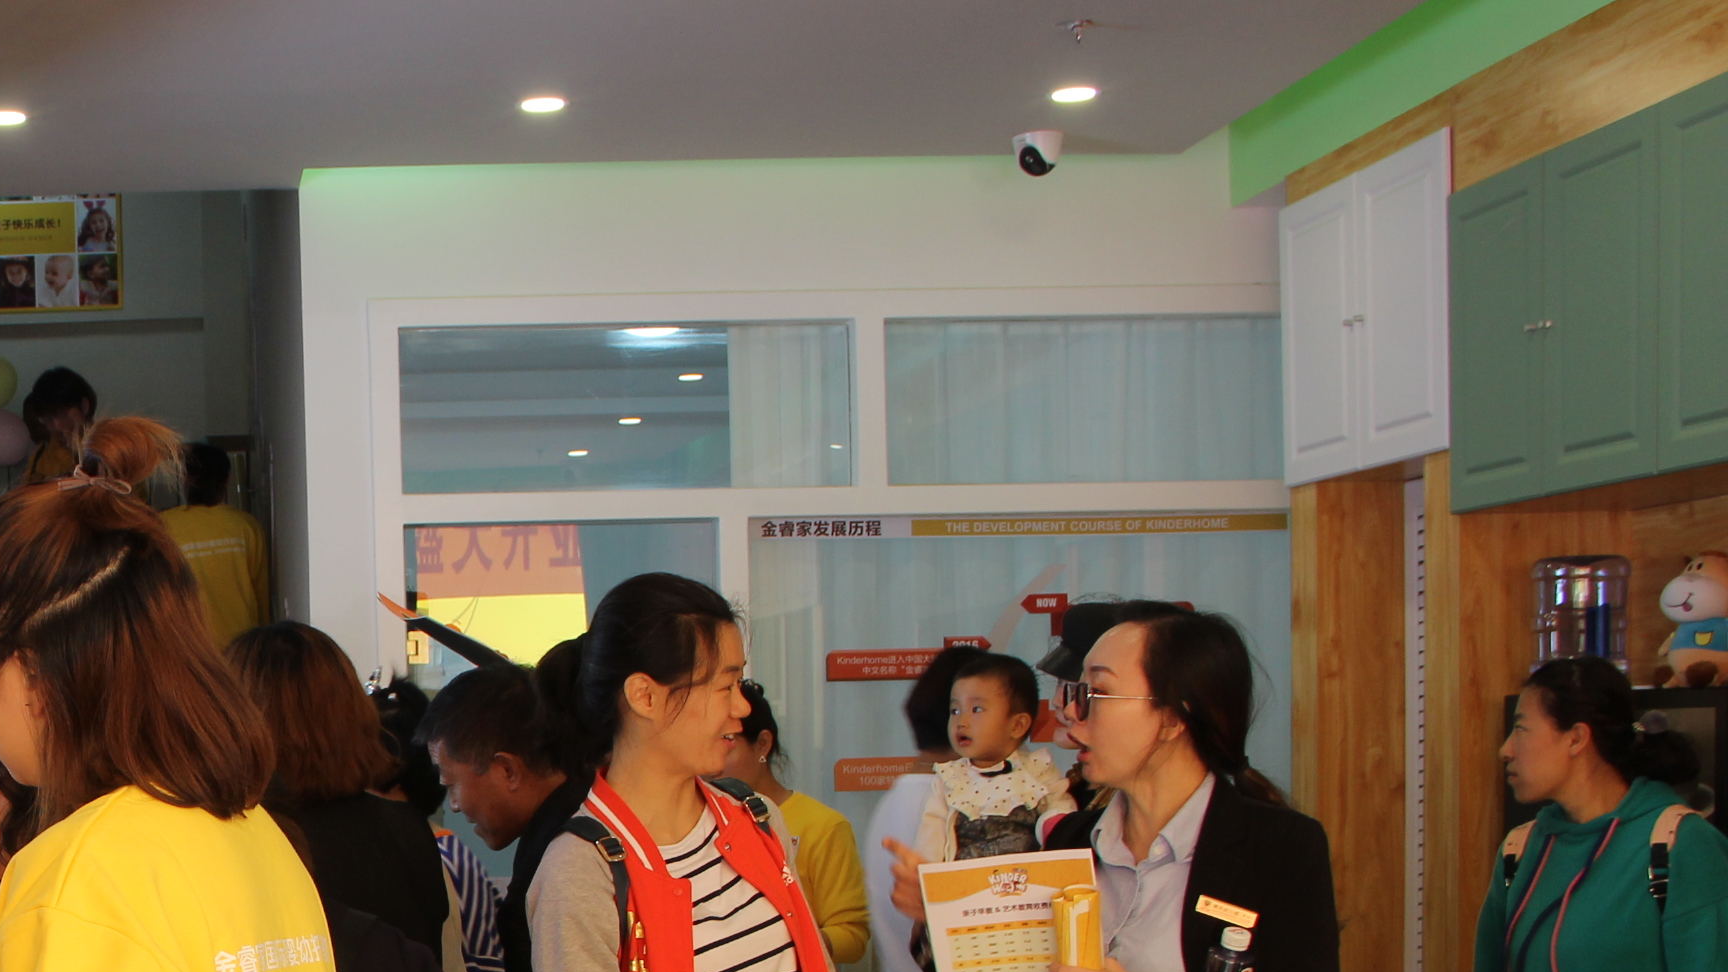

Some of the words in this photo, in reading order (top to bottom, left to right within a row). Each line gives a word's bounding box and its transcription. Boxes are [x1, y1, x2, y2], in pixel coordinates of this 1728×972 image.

[761, 519, 882, 538] 金睿家发展历程
[945, 521, 970, 532] THE
[973, 521, 1066, 532] DEVELOPMENT
[1070, 520, 1122, 531] COURSE
[1126, 519, 1142, 530] OF
[1146, 518, 1229, 530] KINDERHOME
[1036, 597, 1057, 608] NOW
